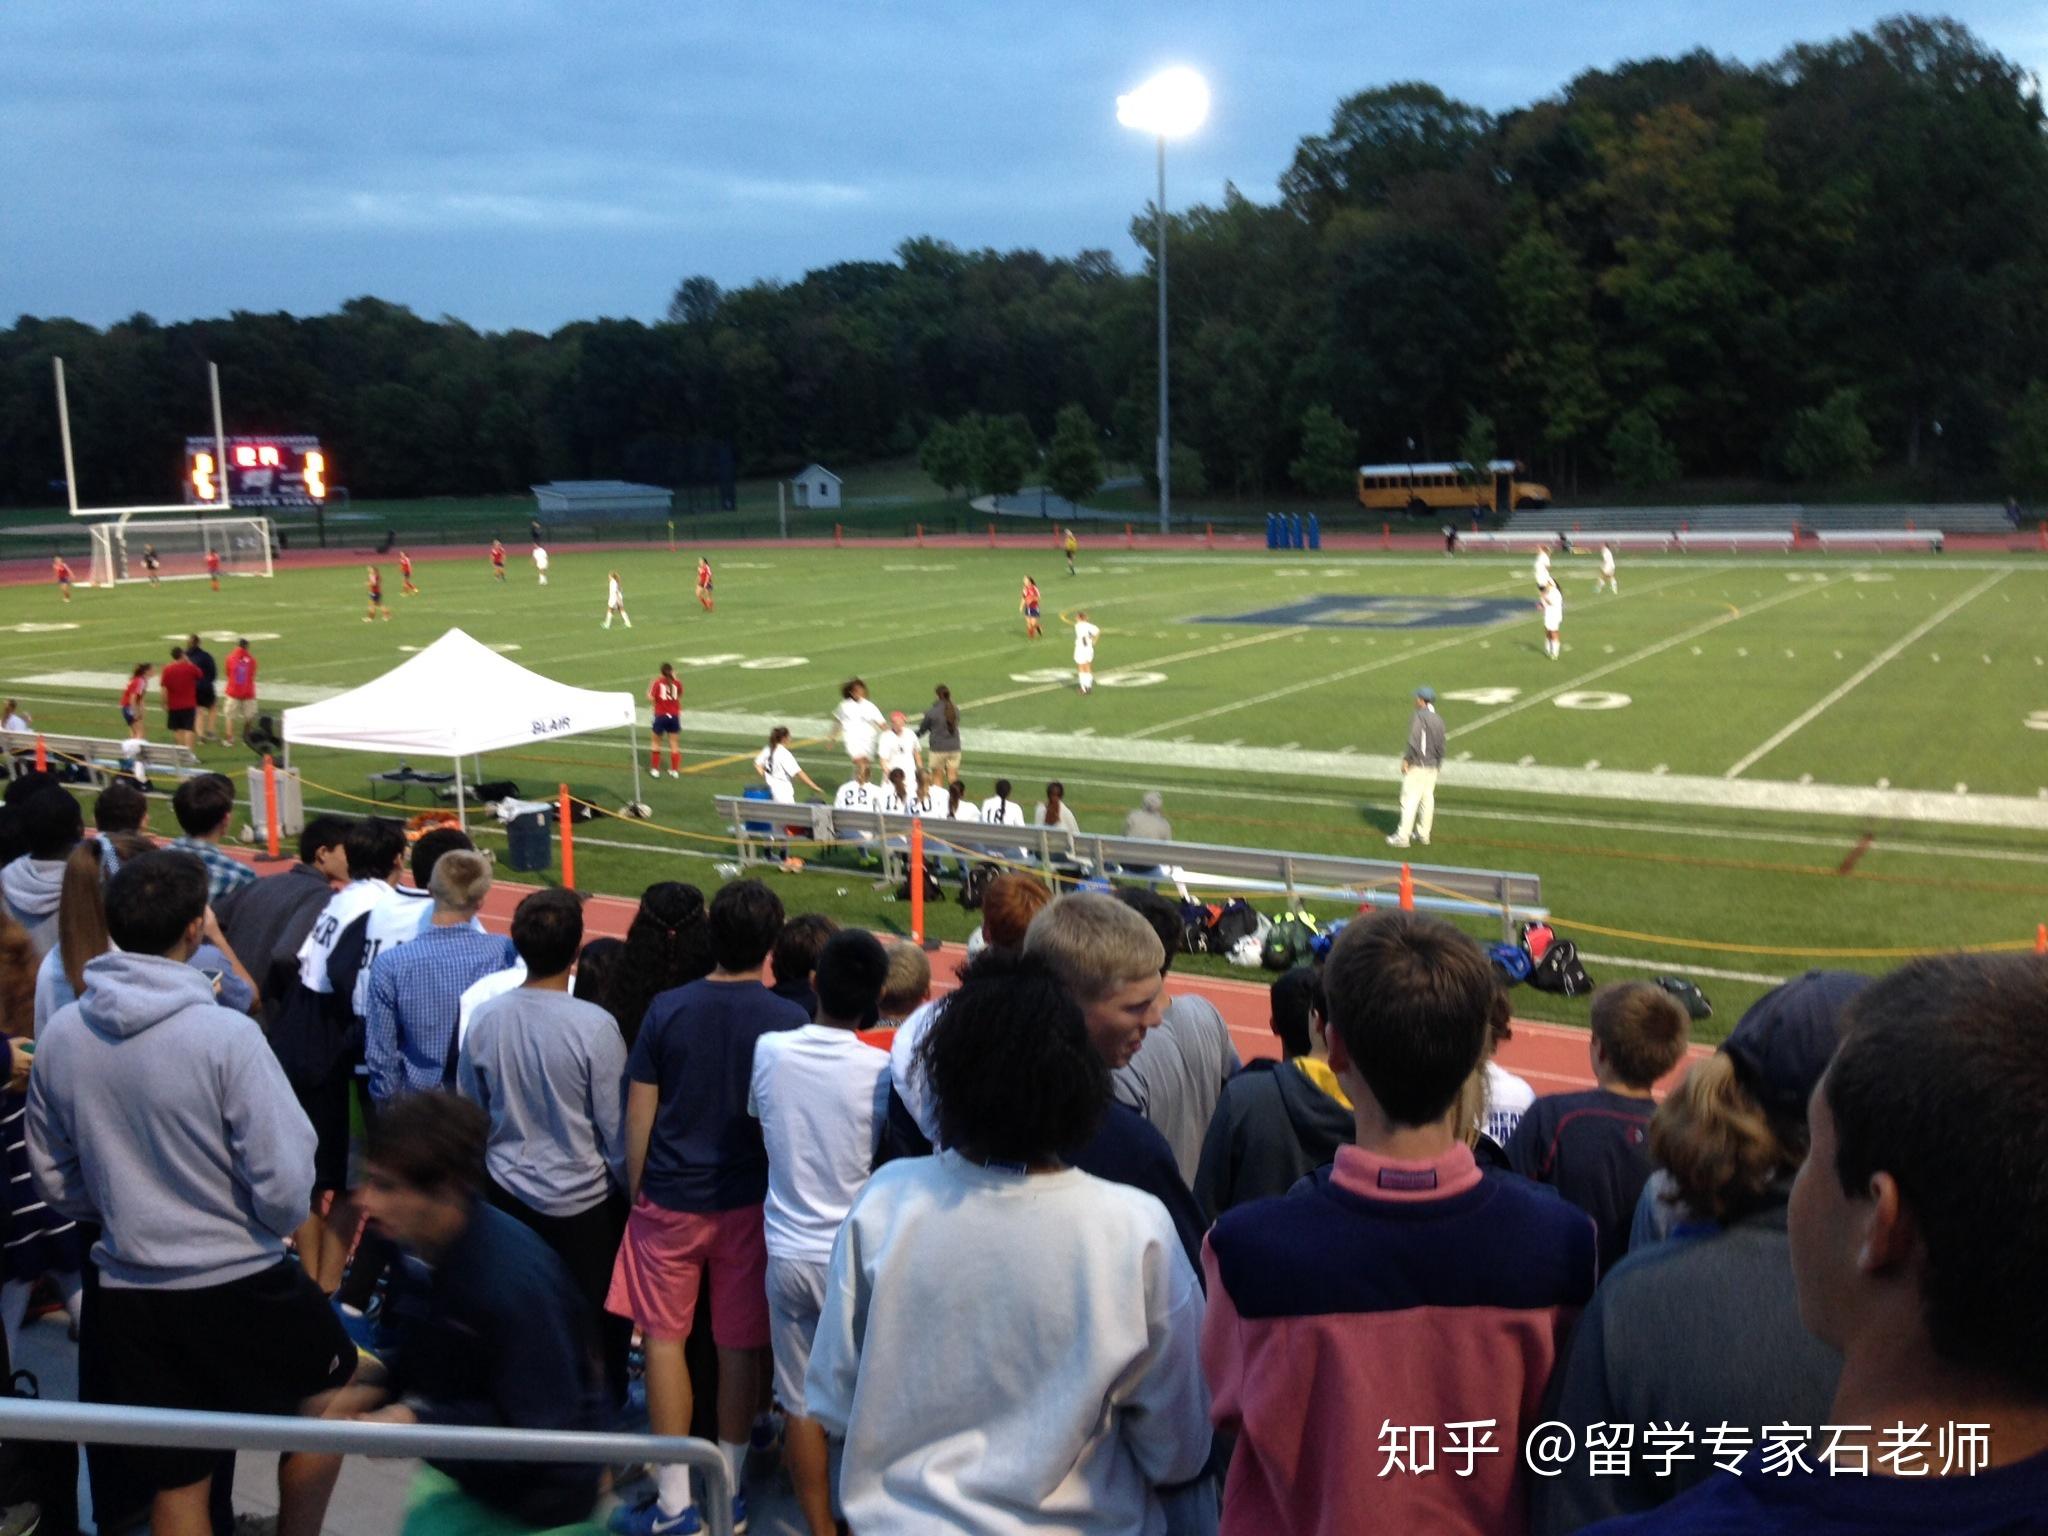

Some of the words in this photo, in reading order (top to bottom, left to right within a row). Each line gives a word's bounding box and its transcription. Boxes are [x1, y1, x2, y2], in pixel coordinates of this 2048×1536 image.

[1440, 687, 1632, 710] 40
[532, 717, 570, 735] BLAIR
[845, 788, 868, 806] 22
